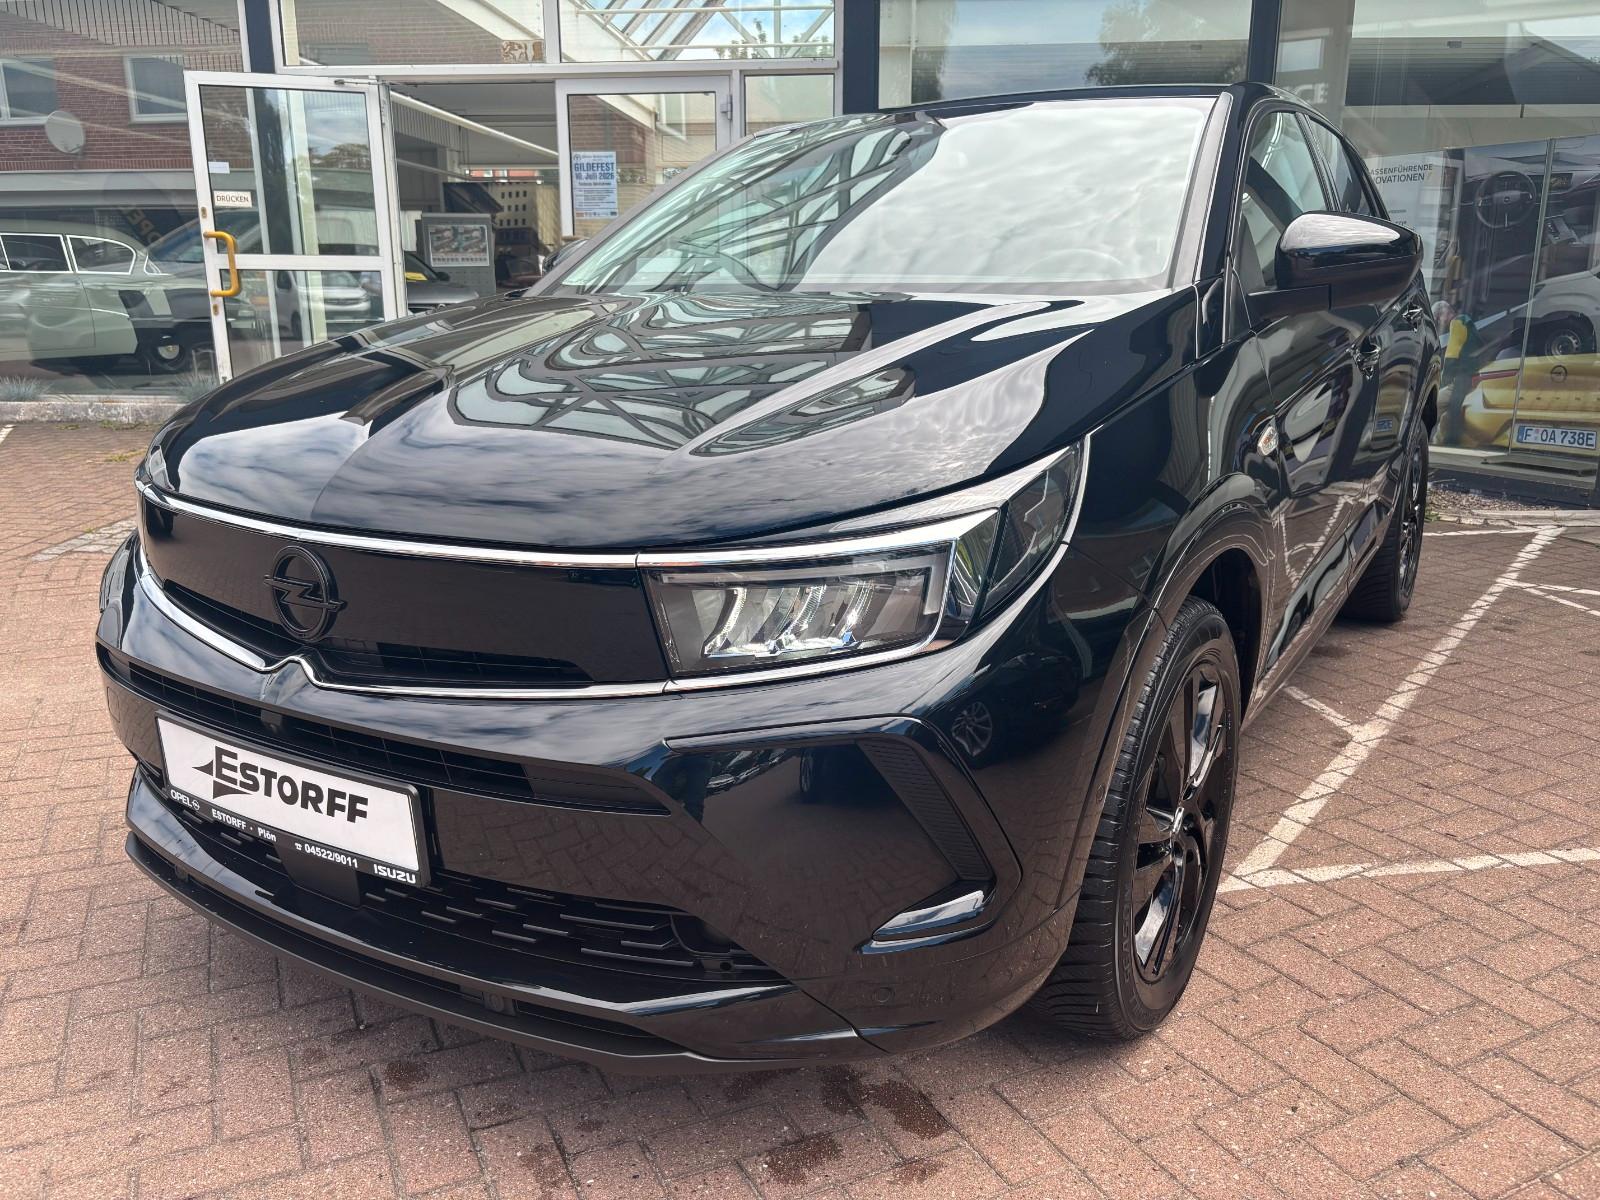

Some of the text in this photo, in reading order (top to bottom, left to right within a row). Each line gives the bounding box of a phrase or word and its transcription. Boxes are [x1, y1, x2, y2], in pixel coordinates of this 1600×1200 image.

[575, 162, 614, 172] GILDEFEST
[1368, 163, 1433, 175] ASSENFÜHRENDE
[1374, 173, 1425, 185] OVATIONEN
[216, 194, 249, 203] DRÜCKEN
[1524, 428, 1533, 441] F
[1560, 430, 1595, 447] 738E
[214, 745, 369, 823] ESTORFF
[170, 789, 192, 808] OPEL
[211, 808, 277, 842] ESTORFF Plön
[304, 843, 359, 869] 04522/9011
[373, 863, 416, 885] ISUZU
